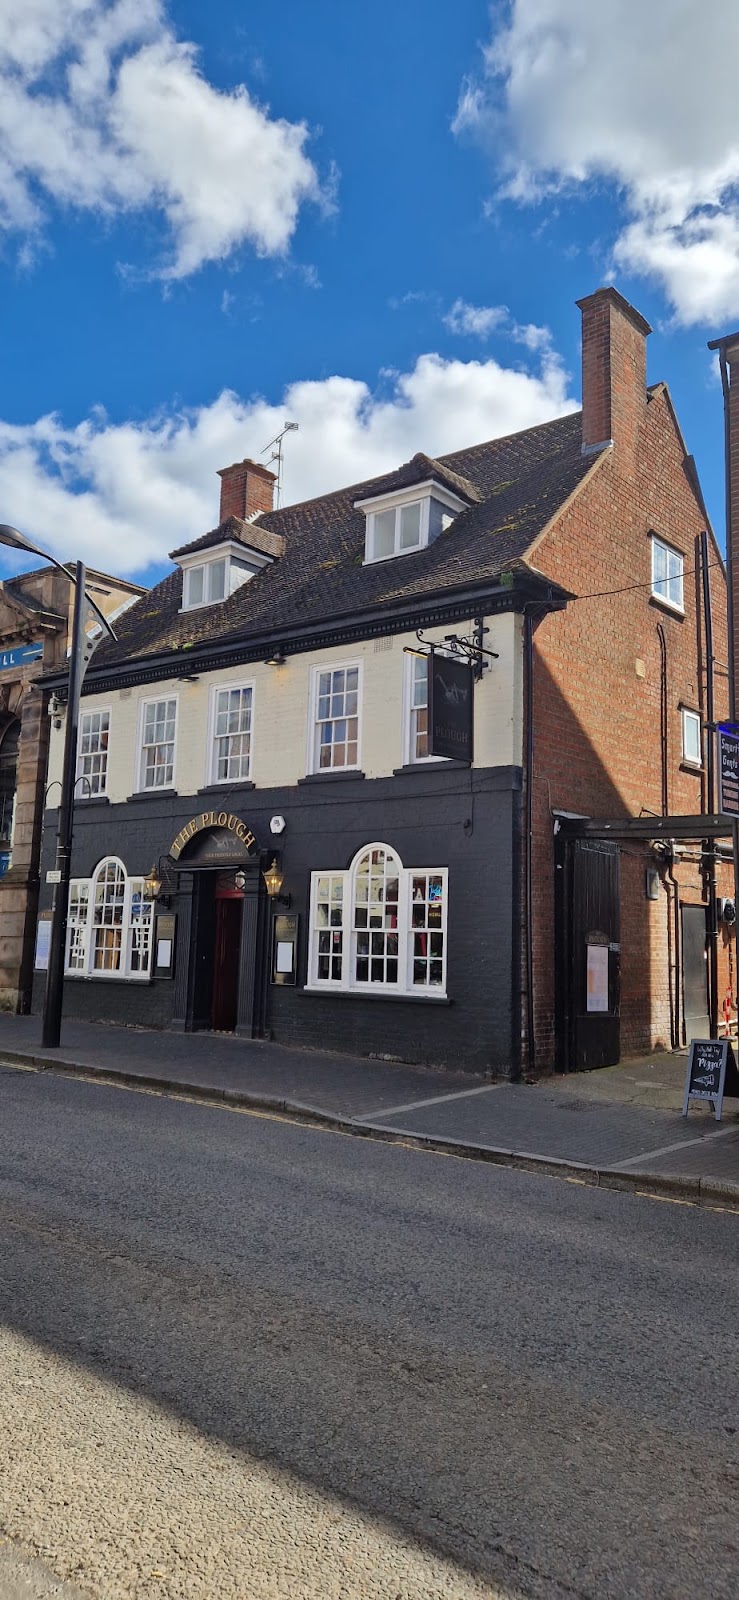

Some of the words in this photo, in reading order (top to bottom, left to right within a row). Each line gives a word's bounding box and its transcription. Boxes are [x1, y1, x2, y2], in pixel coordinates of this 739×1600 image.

[1, 653, 15, 666] LL
[435, 725, 468, 743] PLOUGH
[171, 819, 199, 851] THE
[200, 811, 256, 849] PLOUGH
[697, 1058, 722, 1071] Pizza?
